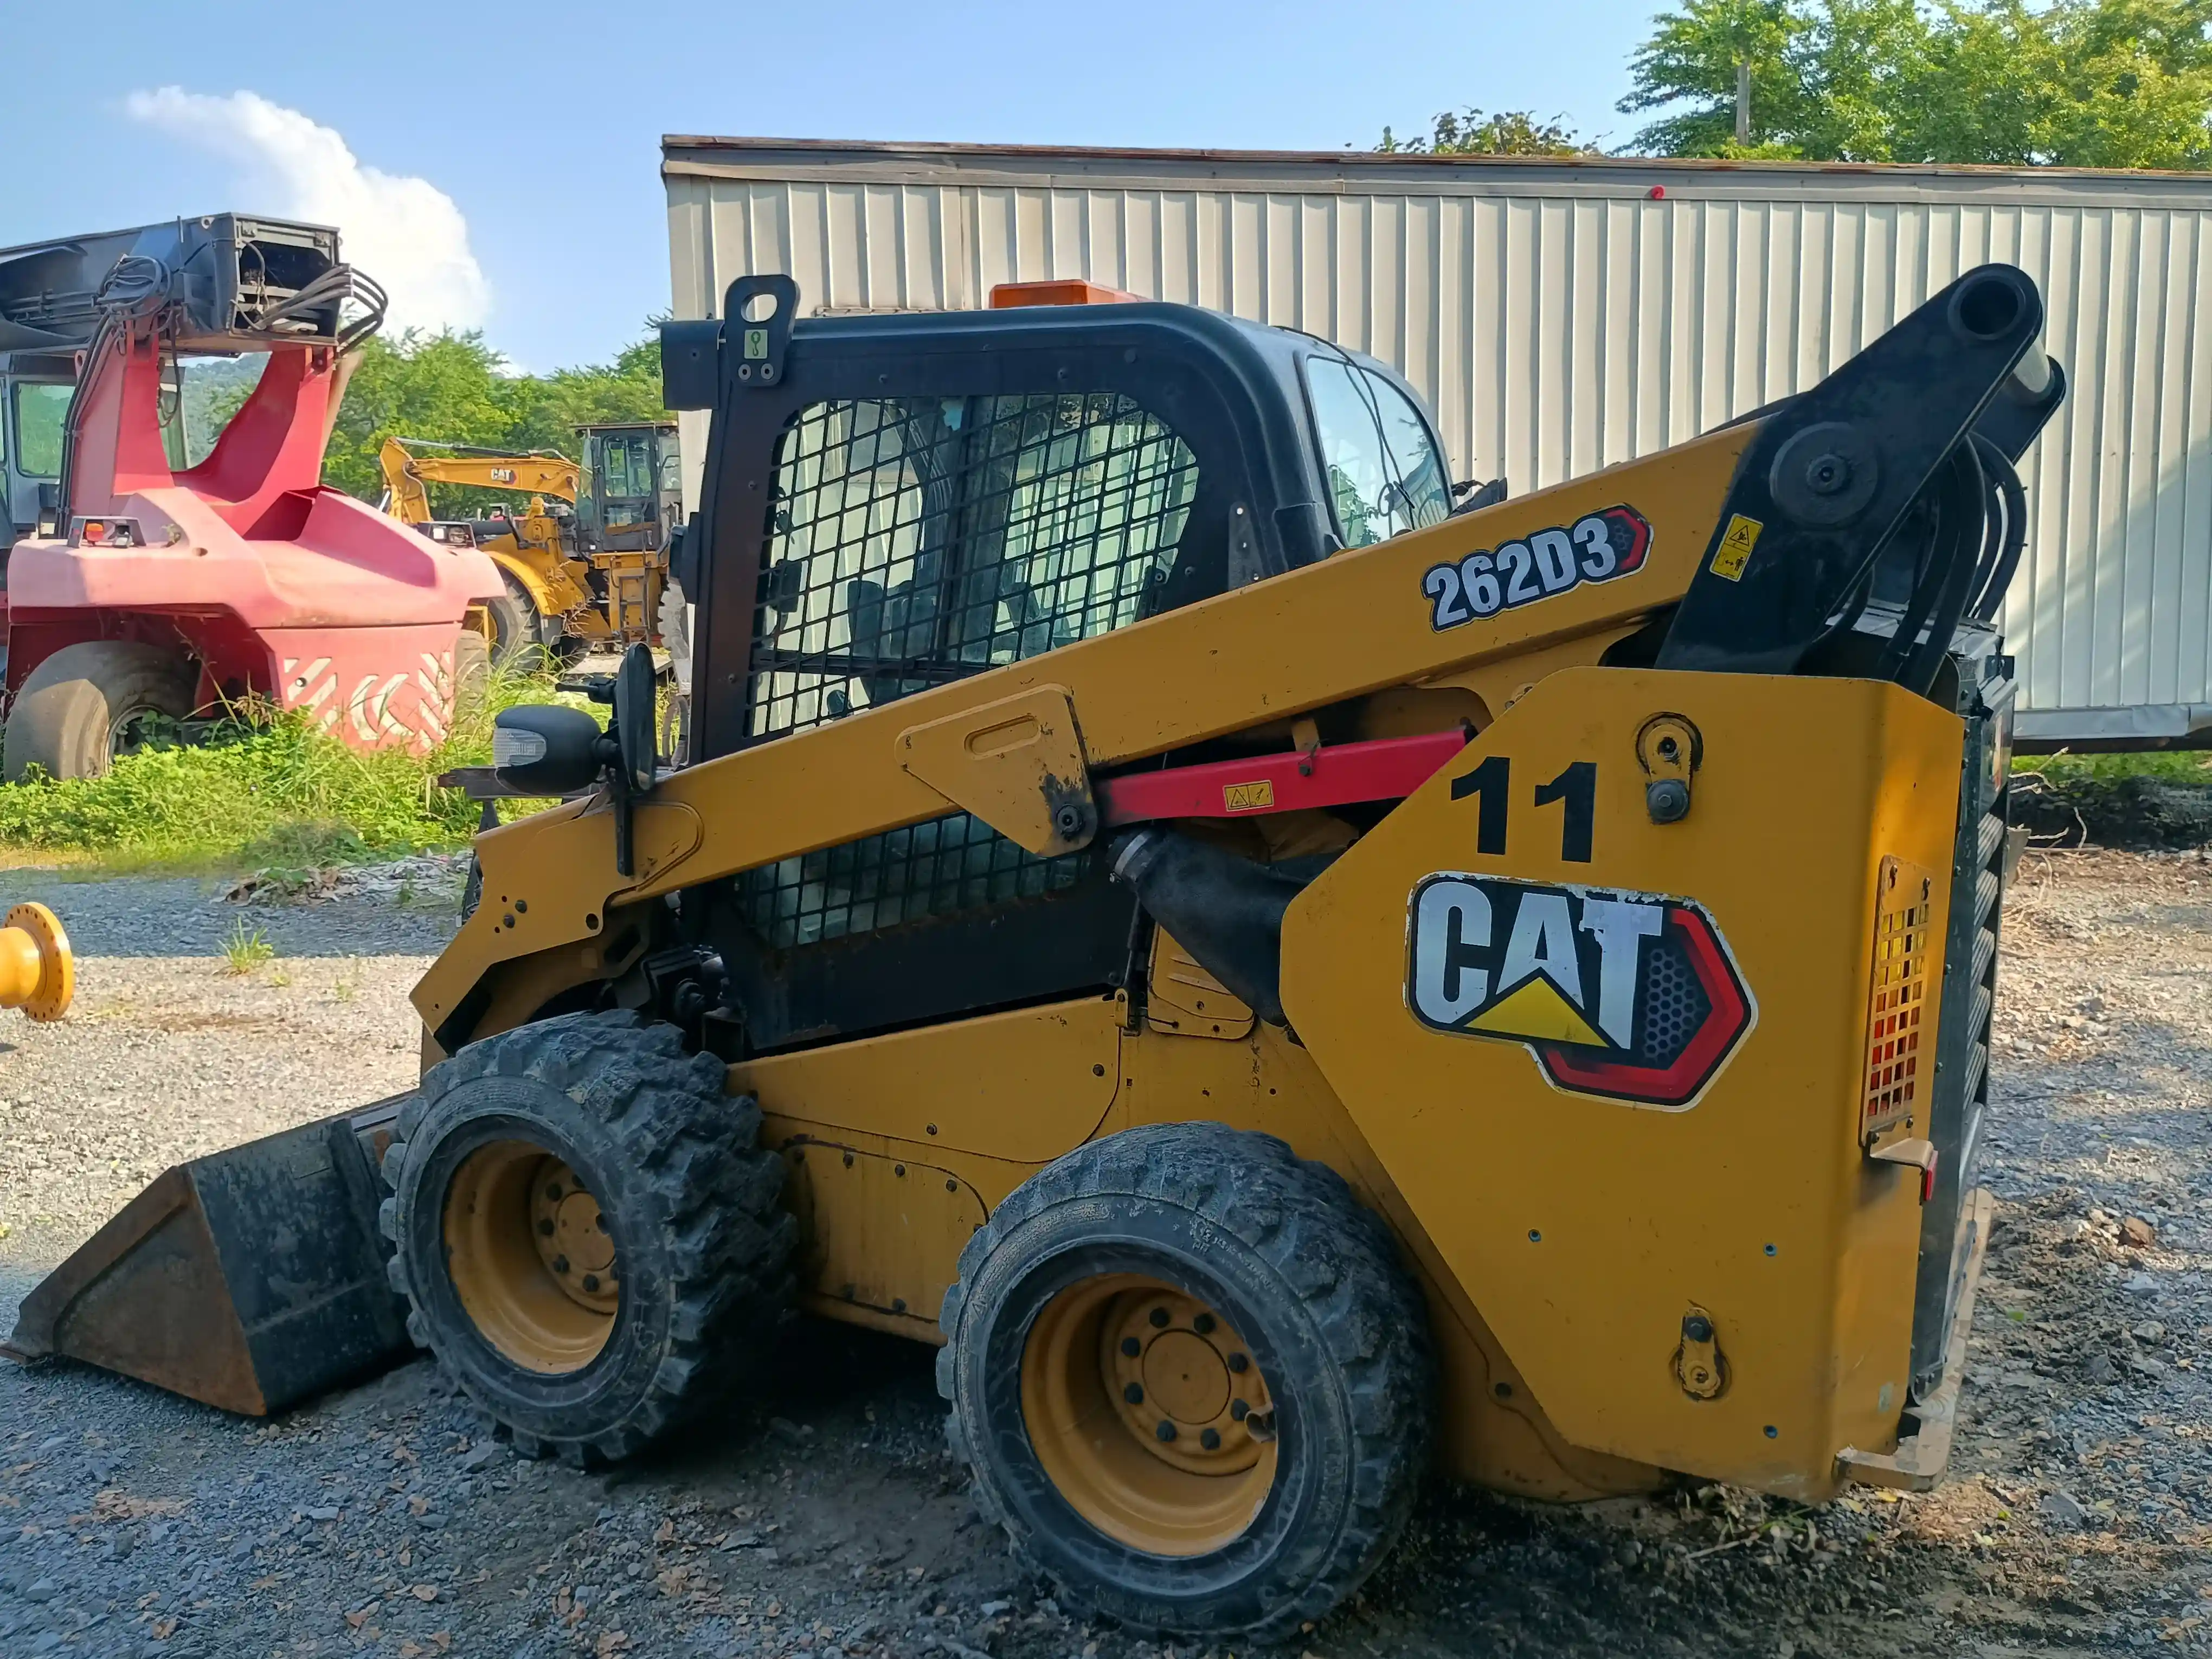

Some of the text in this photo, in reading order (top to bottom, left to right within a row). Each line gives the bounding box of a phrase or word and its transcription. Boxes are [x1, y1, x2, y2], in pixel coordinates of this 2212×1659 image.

[491, 468, 511, 481] CAT
[1426, 518, 1616, 626] 262D3
[1451, 756, 1597, 863] 11
[1415, 881, 1663, 1050] CAT
